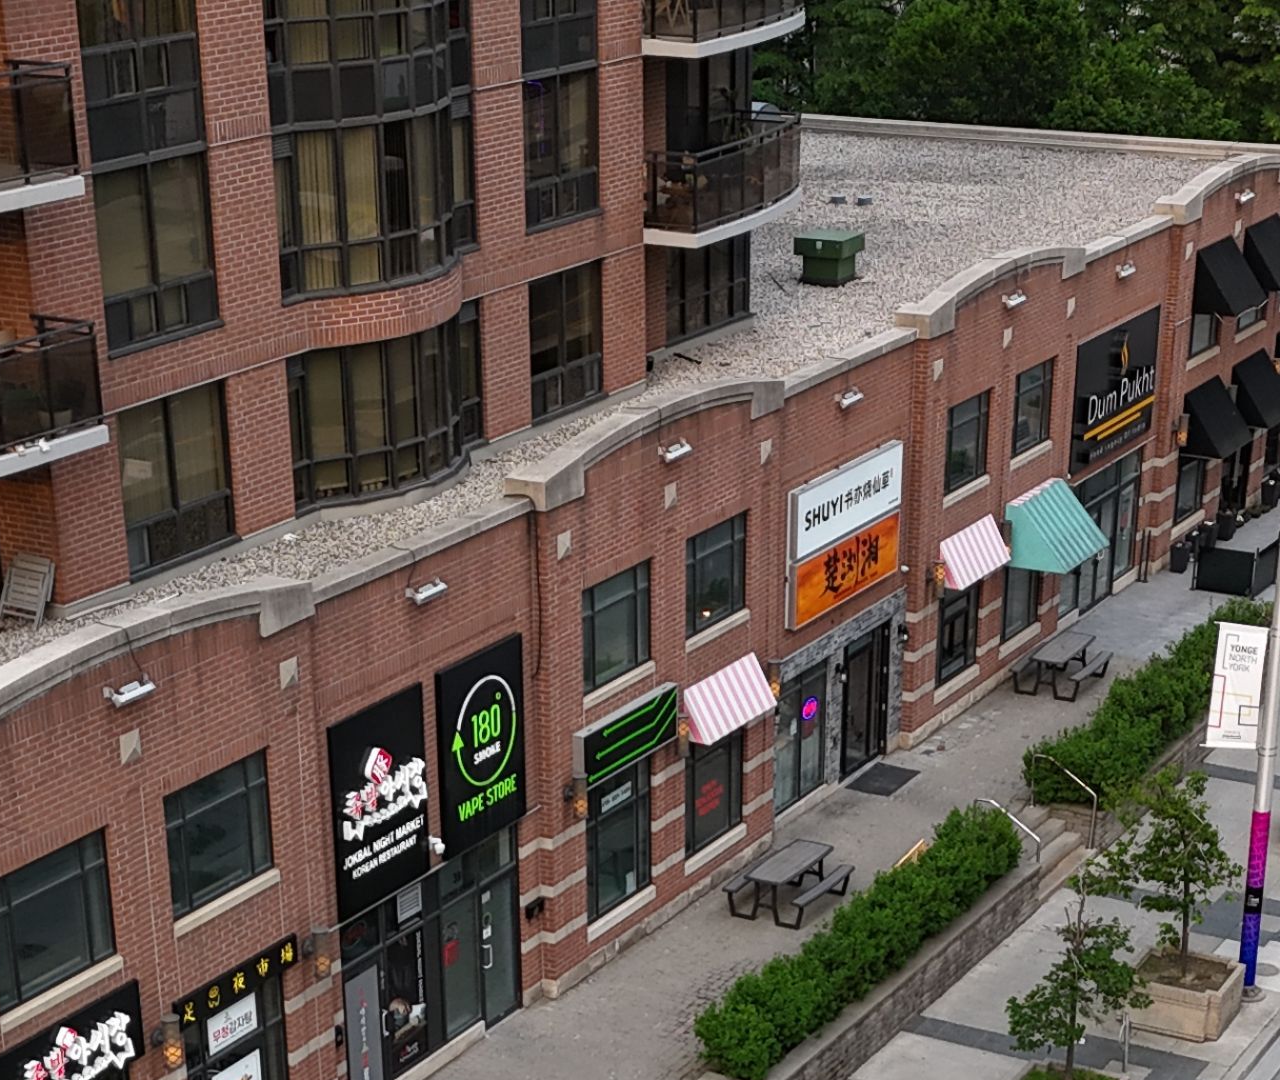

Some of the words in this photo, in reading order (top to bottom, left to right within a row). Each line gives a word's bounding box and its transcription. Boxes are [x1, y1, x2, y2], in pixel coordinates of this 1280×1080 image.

[1087, 390, 1118, 425] Dum
[1120, 365, 1154, 407] Pukht
[804, 493, 843, 532] SHUYI
[1228, 653, 1258, 665] NORTH
[1228, 662, 1251, 673] YORK
[1230, 643, 1259, 656] YONGE
[473, 741, 501, 766] SMOKE
[458, 792, 485, 822] VAPE
[486, 773, 518, 806] STORE
[343, 845, 373, 871] JOKBAL
[373, 830, 395, 854] NIGHT
[395, 813, 424, 841] MARKET
[352, 857, 379, 880] KOREAN
[379, 834, 417, 864] RESTAURANT
